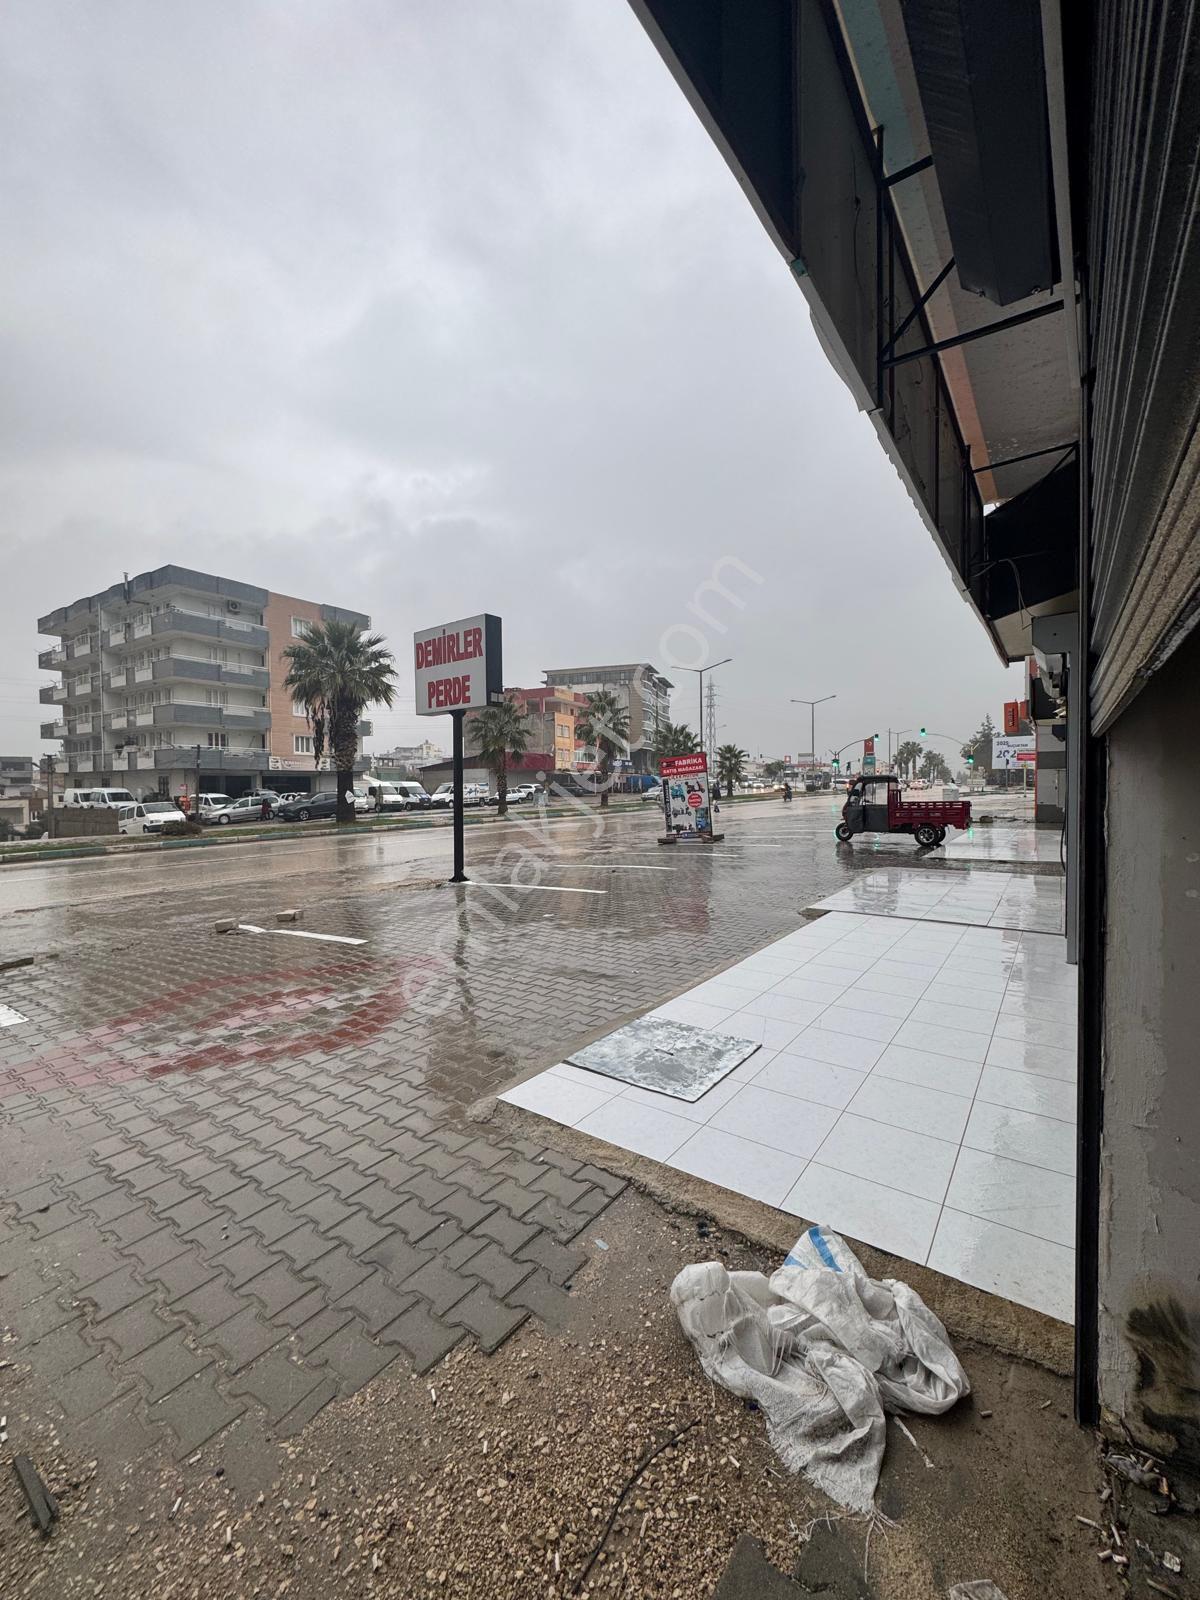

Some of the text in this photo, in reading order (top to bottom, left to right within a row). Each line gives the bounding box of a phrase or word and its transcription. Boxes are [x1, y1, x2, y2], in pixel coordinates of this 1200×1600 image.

[416, 627, 483, 670] DEMİRLER
[428, 674, 471, 709] PERDE
[674, 757, 702, 766] FABRİKA
